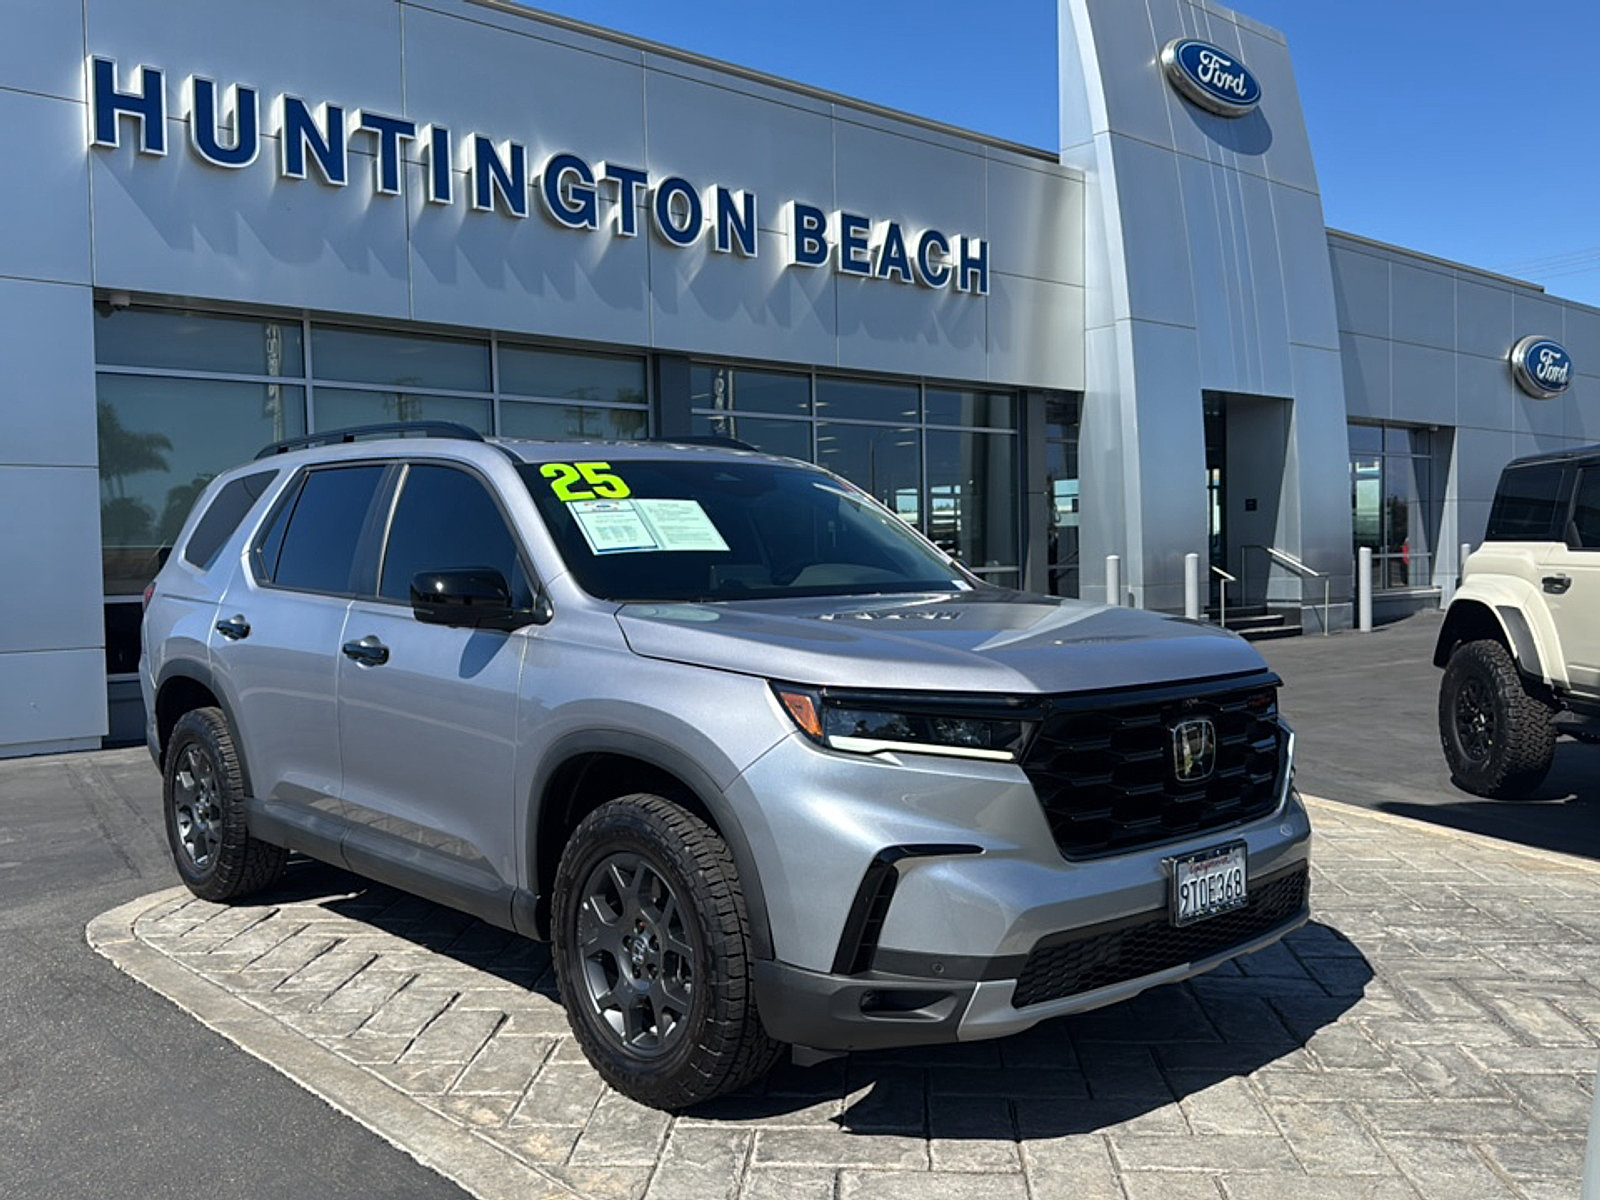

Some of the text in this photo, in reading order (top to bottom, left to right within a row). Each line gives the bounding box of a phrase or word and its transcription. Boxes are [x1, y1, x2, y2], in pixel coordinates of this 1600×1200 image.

[1198, 50, 1247, 96] Ford
[88, 55, 990, 296] HUNTINGTON BEACH
[1537, 349, 1569, 383] Ford
[539, 462, 631, 501] 25
